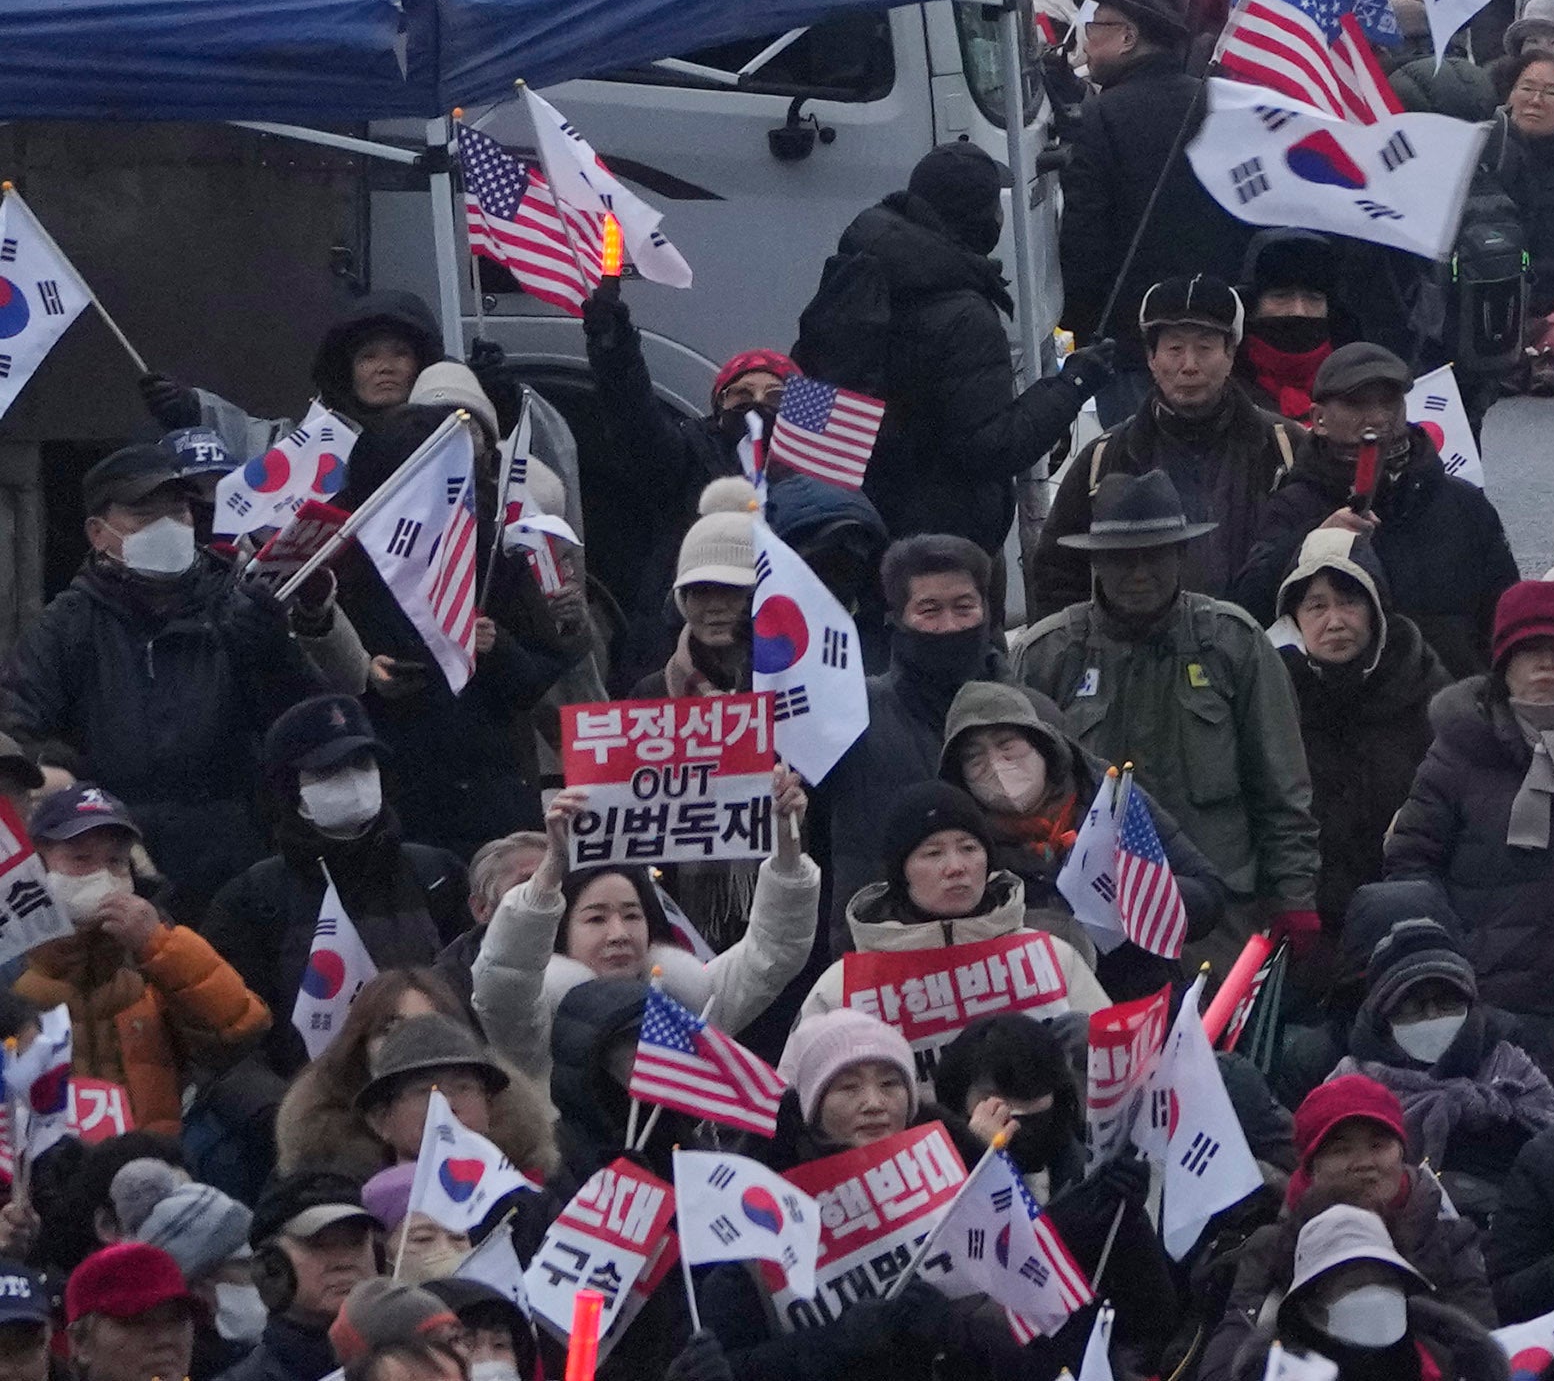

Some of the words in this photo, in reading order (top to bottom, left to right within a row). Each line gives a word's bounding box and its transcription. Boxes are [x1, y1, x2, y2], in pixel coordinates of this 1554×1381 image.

[575, 695, 771, 762] 부정선거
[632, 764, 718, 800] OUT
[572, 799, 771, 863] 입법독재
[853, 941, 1060, 1022] 탄핵반대
[818, 1128, 963, 1243] 핵반대
